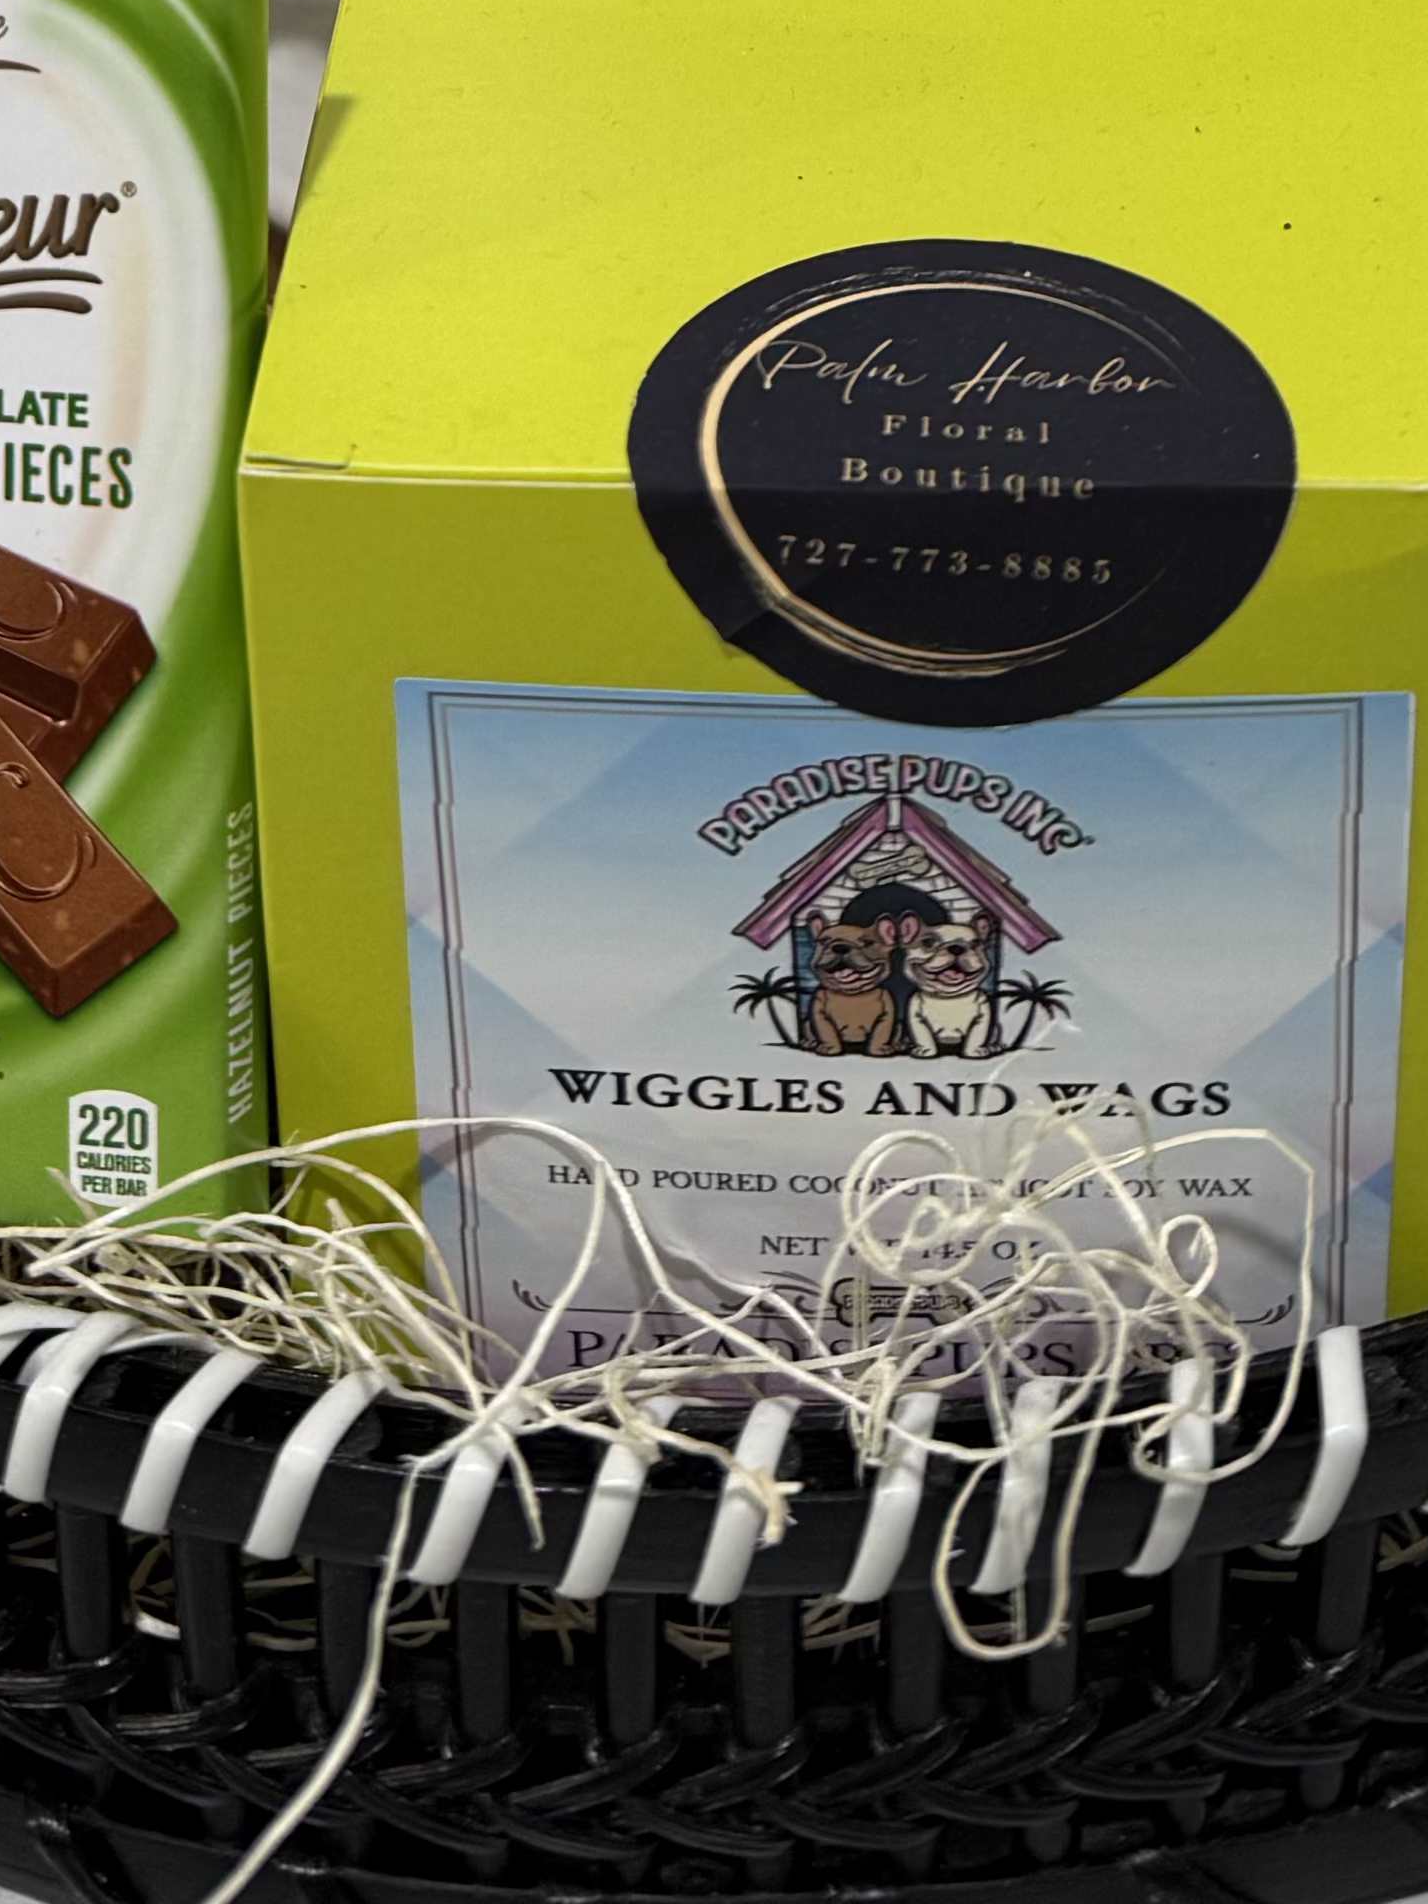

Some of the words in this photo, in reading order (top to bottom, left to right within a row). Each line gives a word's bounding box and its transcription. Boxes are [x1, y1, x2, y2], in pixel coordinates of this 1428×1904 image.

[756, 338, 928, 405] Palm
[950, 340, 1178, 405] Harbor
[882, 413, 1052, 446] Floral
[839, 455, 1097, 503] Boutique
[778, 533, 1113, 587] 727-773-8885
[698, 753, 892, 856] PARADISE
[898, 754, 1014, 813] PUPS
[227, 800, 254, 924] PIECES
[227, 937, 254, 1124] HAZELNUT
[548, 1067, 846, 1117] WIGGLES
[867, 1079, 1018, 1119] AND
[78, 1104, 149, 1151] 220
[76, 1151, 152, 1175] CALORIES
[81, 1174, 113, 1195] PER
[116, 1178, 148, 1197] BAR
[547, 1164, 640, 1188] HAD
[652, 1169, 778, 1194] POURED
[1178, 1177, 1253, 1198] WAX
[759, 1235, 829, 1256] NET
